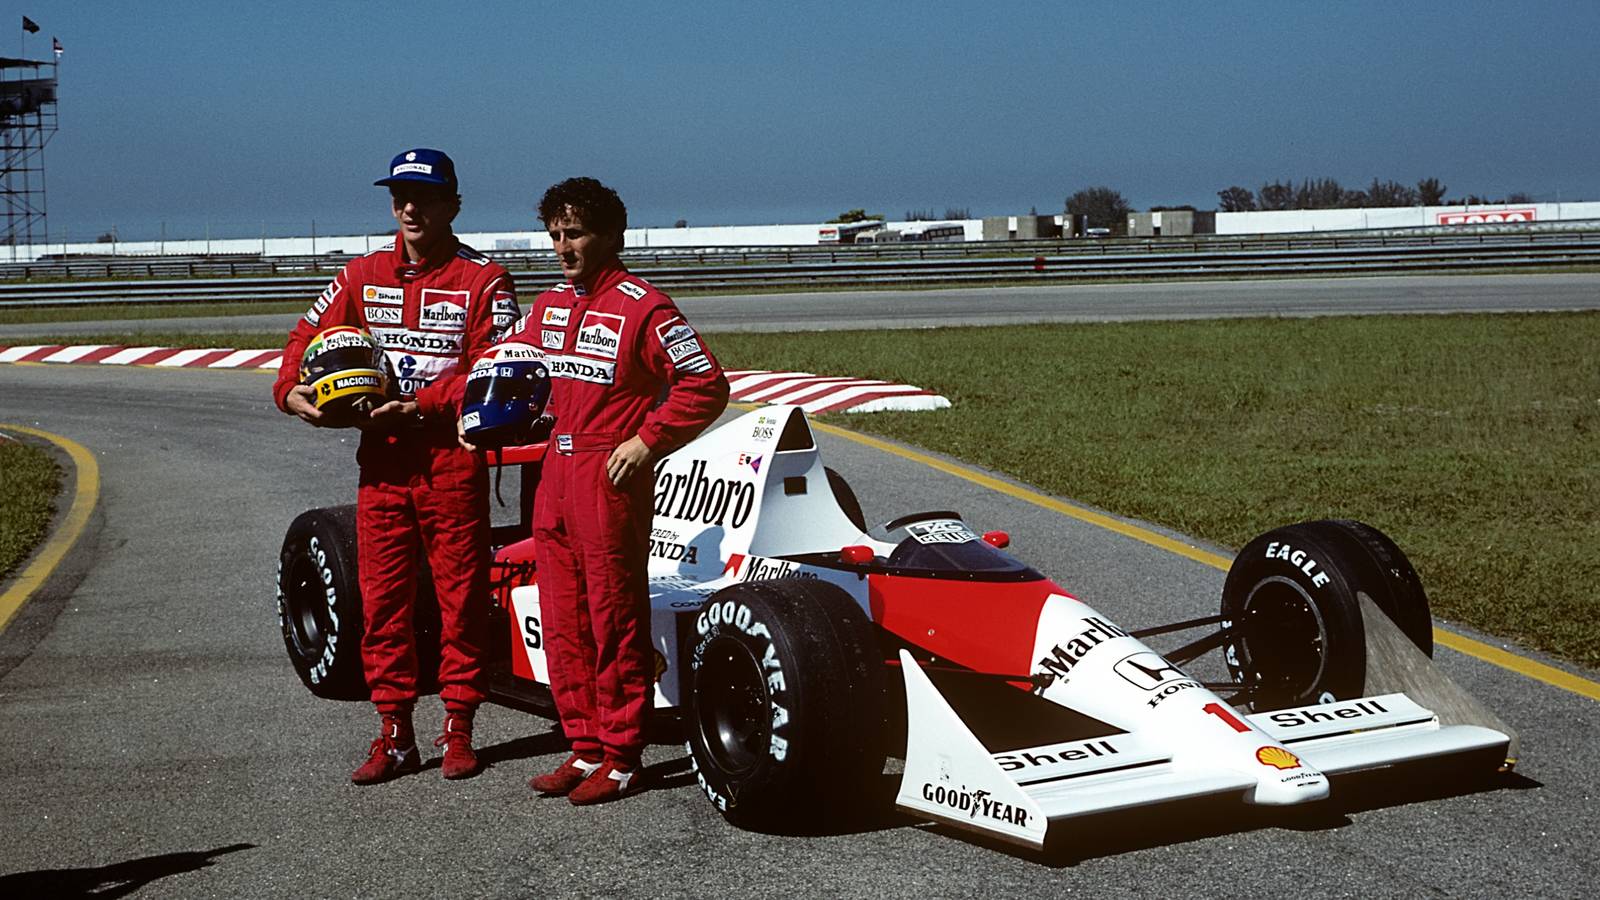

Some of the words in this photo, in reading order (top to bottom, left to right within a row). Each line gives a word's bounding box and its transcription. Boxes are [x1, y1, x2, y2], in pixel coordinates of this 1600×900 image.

[378, 292, 402, 300] Shell
[367, 307, 400, 320] BOSS
[422, 305, 467, 322] Marlboro
[383, 333, 459, 350] HONDA
[579, 328, 617, 348] Marlboro
[316, 340, 372, 356] HONDA
[670, 339, 698, 357] BOSS
[551, 361, 612, 380] HONDA
[336, 376, 379, 388] NACIONAL
[752, 426, 775, 439] BOSS
[653, 458, 756, 529] arlboro
[1265, 541, 1331, 589] EAGLE
[1202, 702, 1254, 734] 1
[1268, 699, 1390, 729] Shell
[994, 740, 1120, 773] Shell
